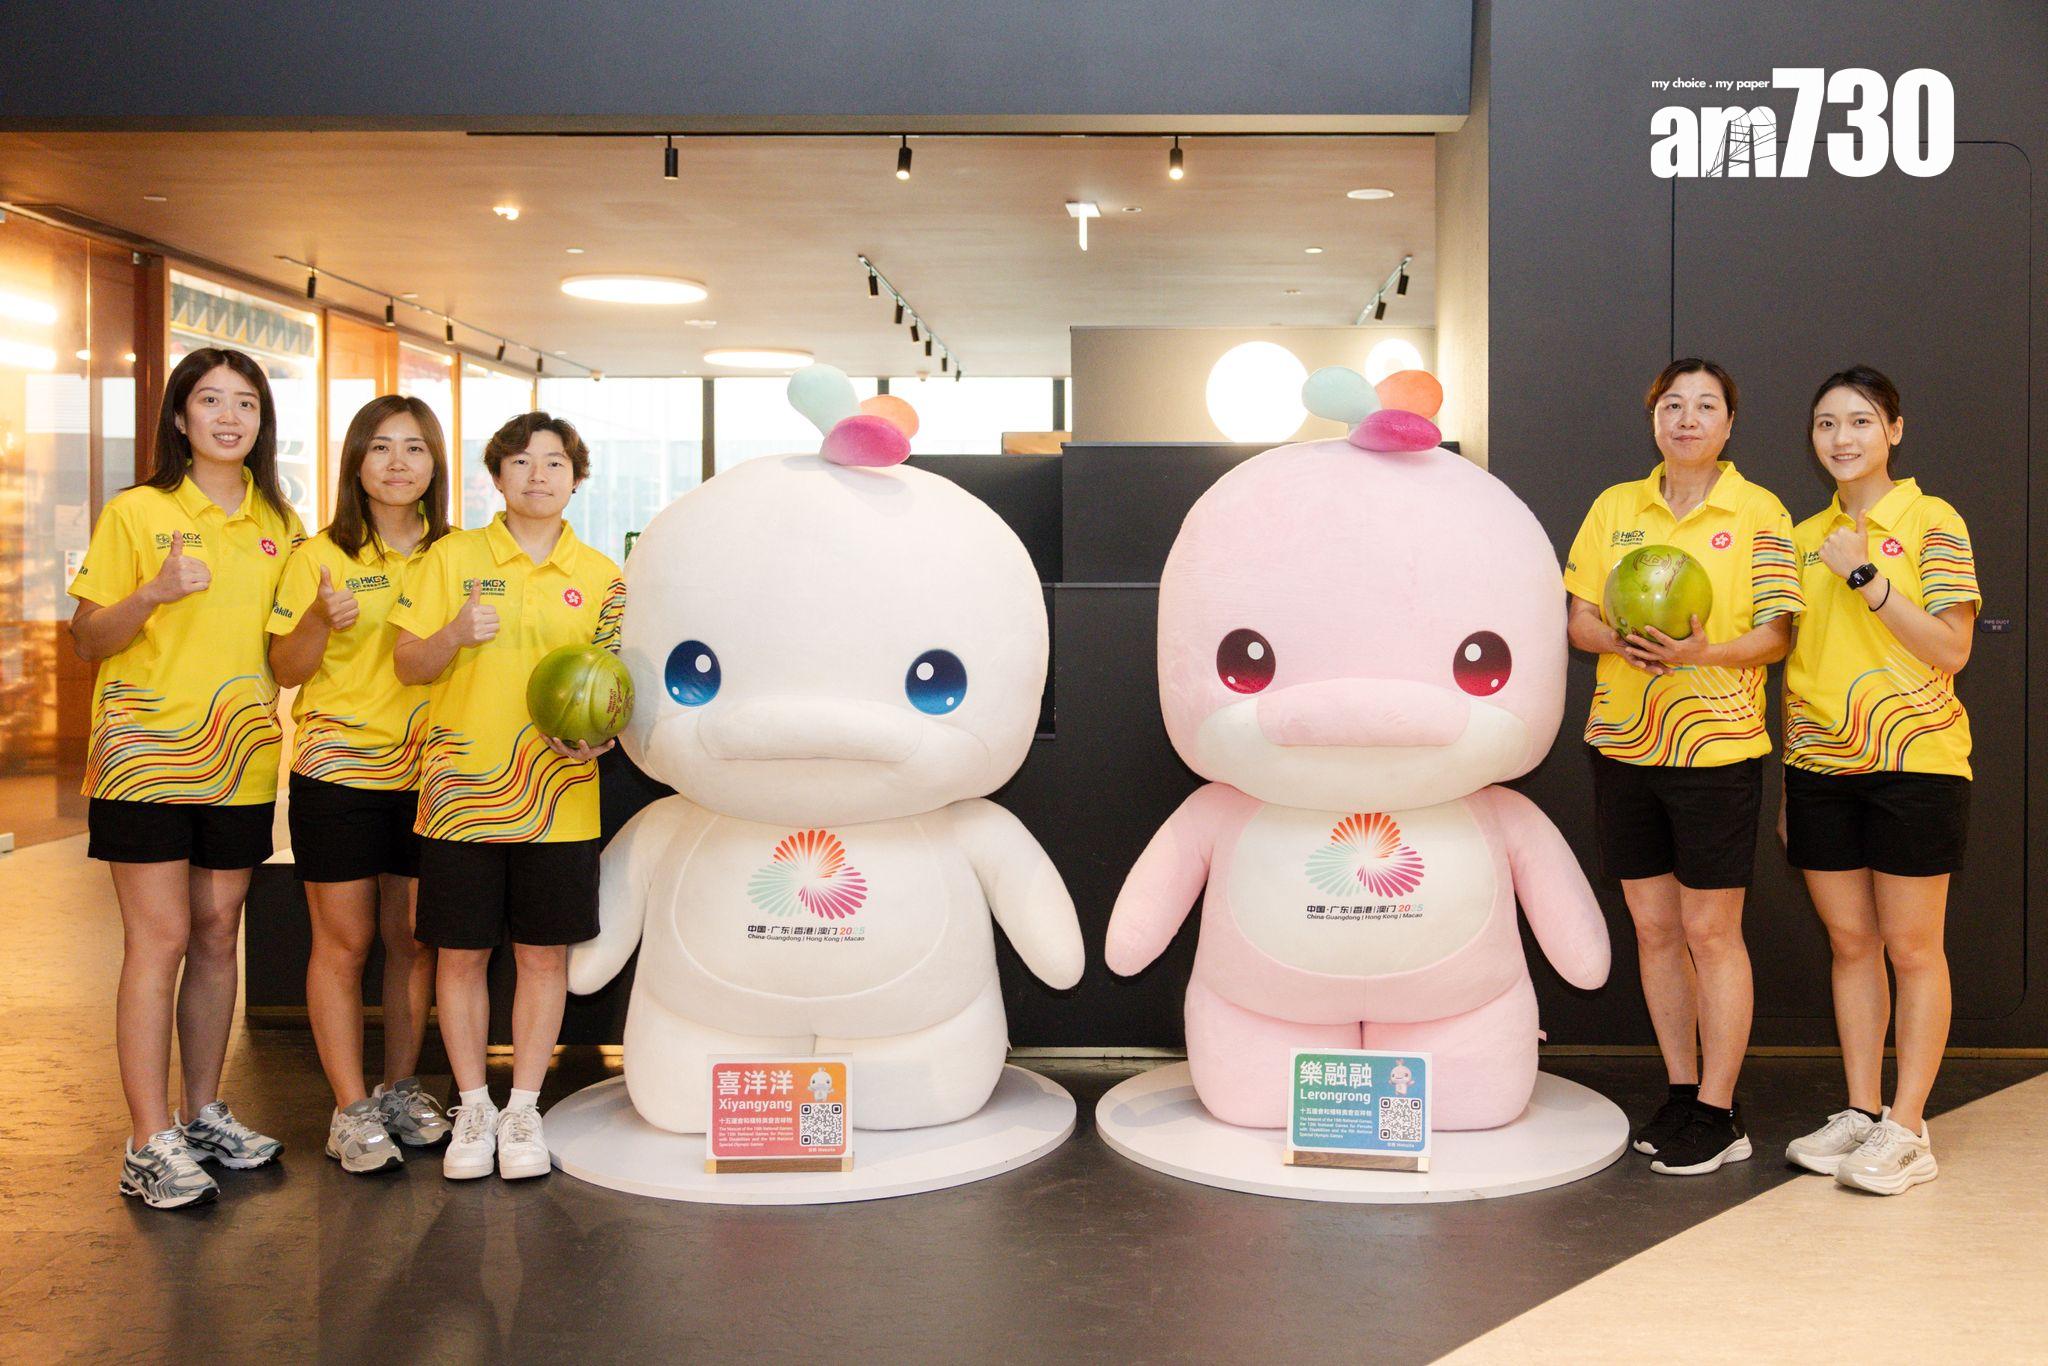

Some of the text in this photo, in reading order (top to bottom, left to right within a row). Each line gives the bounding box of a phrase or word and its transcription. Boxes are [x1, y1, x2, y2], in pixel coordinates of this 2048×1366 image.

[360, 575, 388, 584] HKGX
[717, 1070, 793, 1095] 喜洋洋
[1300, 1061, 1372, 1088] 樂融融
[719, 1098, 793, 1112] Xiyangyang
[1300, 1088, 1371, 1104] Lerongrong
[1897, 1149, 1917, 1169] HOKA
